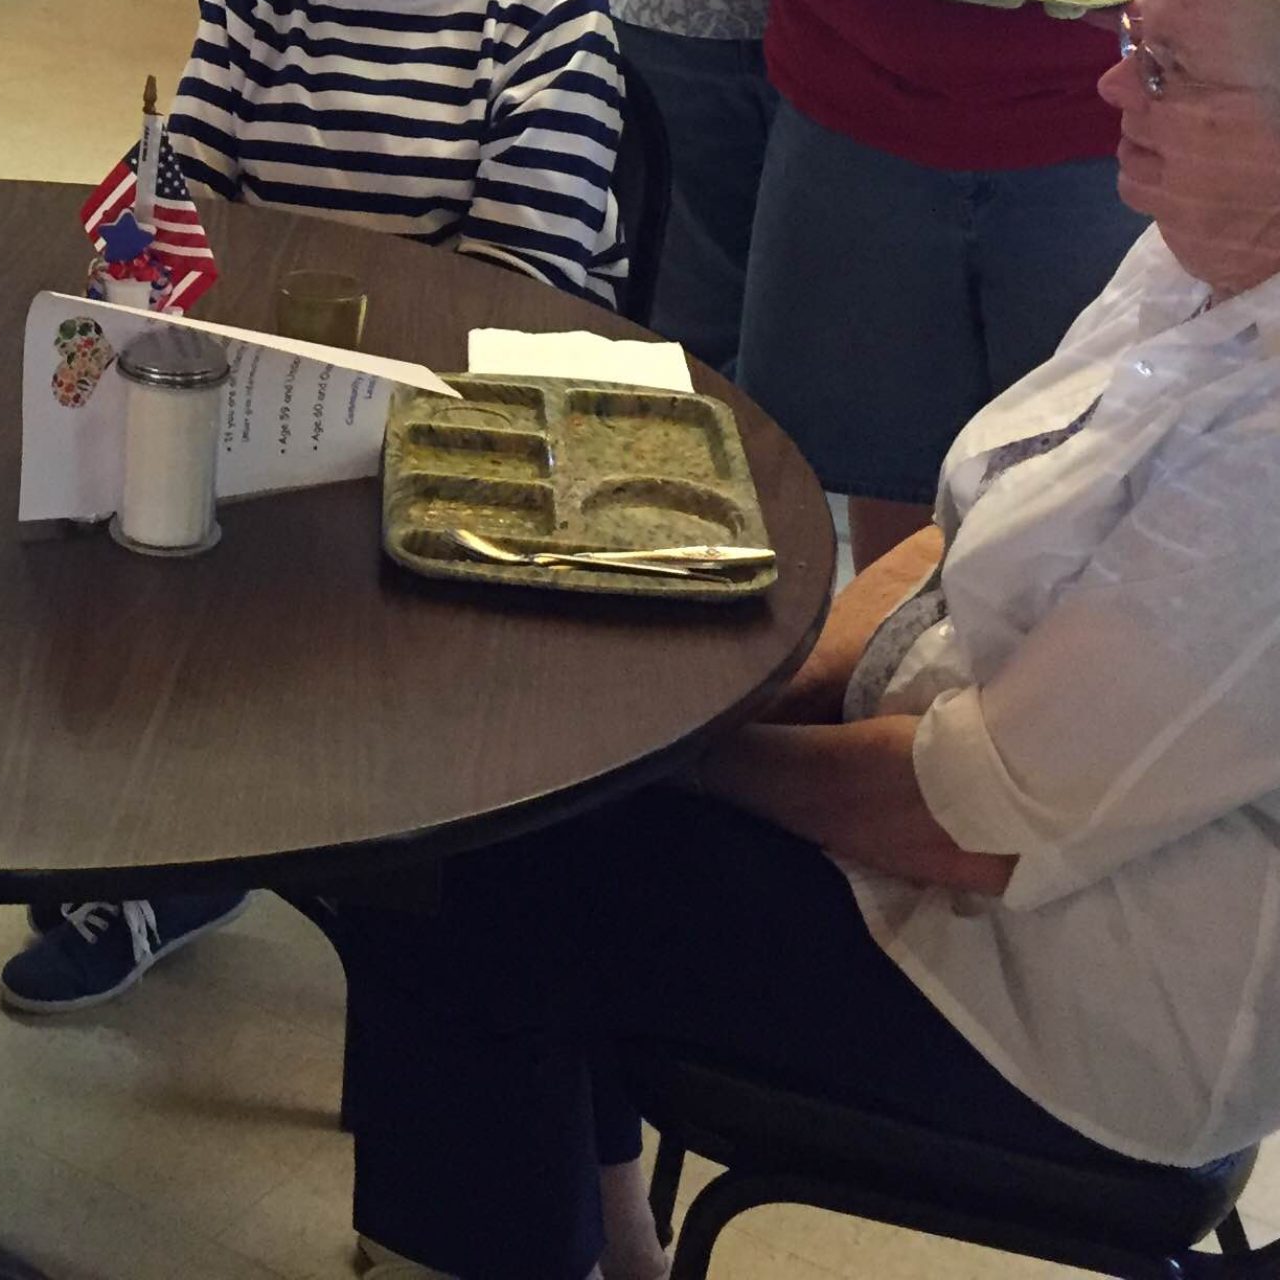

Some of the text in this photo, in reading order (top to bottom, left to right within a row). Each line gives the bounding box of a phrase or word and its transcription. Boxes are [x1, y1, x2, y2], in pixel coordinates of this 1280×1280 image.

[283, 384, 294, 404] and
[317, 383, 327, 401] and
[345, 376, 363, 426] Community
[278, 422, 292, 445] Age
[311, 420, 324, 442] Age
